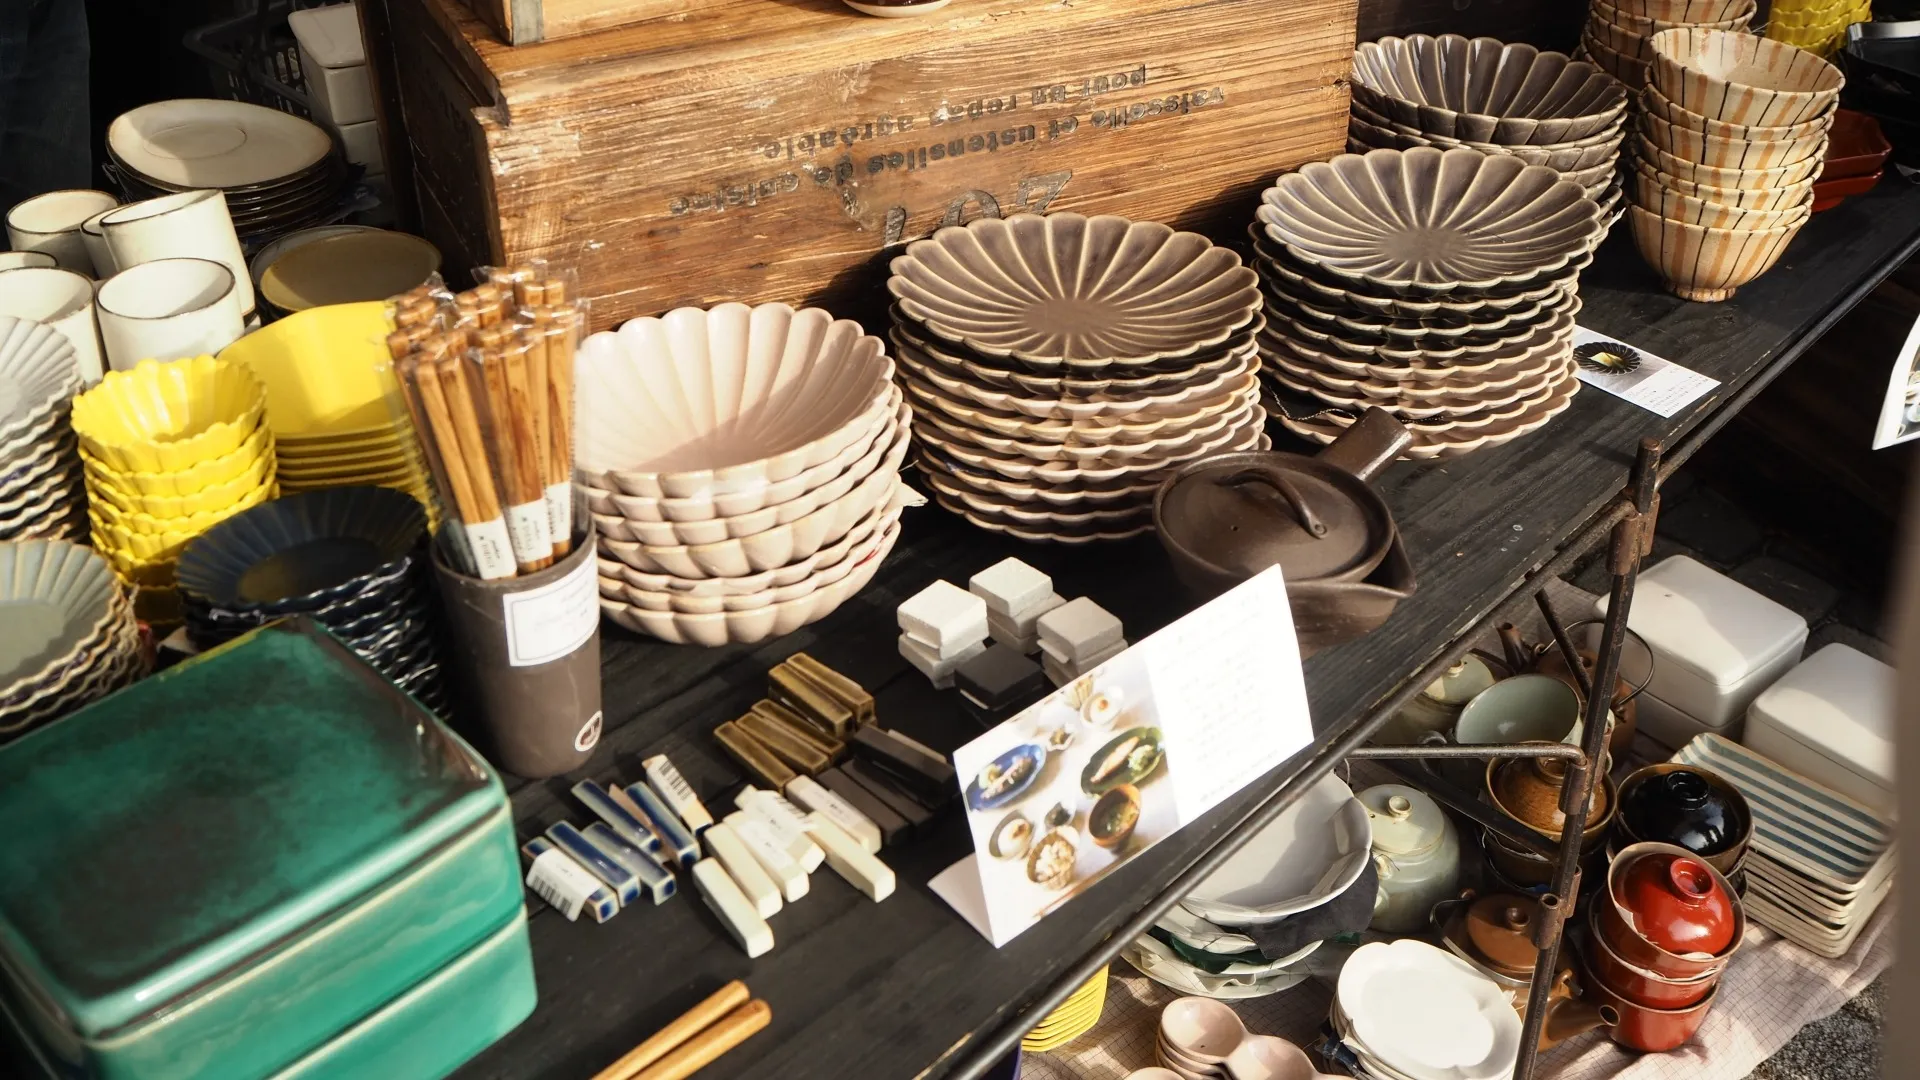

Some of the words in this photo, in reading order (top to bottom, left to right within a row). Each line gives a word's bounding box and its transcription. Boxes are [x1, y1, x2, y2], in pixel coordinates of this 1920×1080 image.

[1031, 85, 1066, 107] un
[1079, 64, 1146, 98] pour
[1091, 87, 1225, 129] vaisselle
[1047, 115, 1079, 140] et
[866, 125, 1035, 176] ustensiles
[813, 162, 854, 187] de
[668, 172, 799, 216] cuisine
